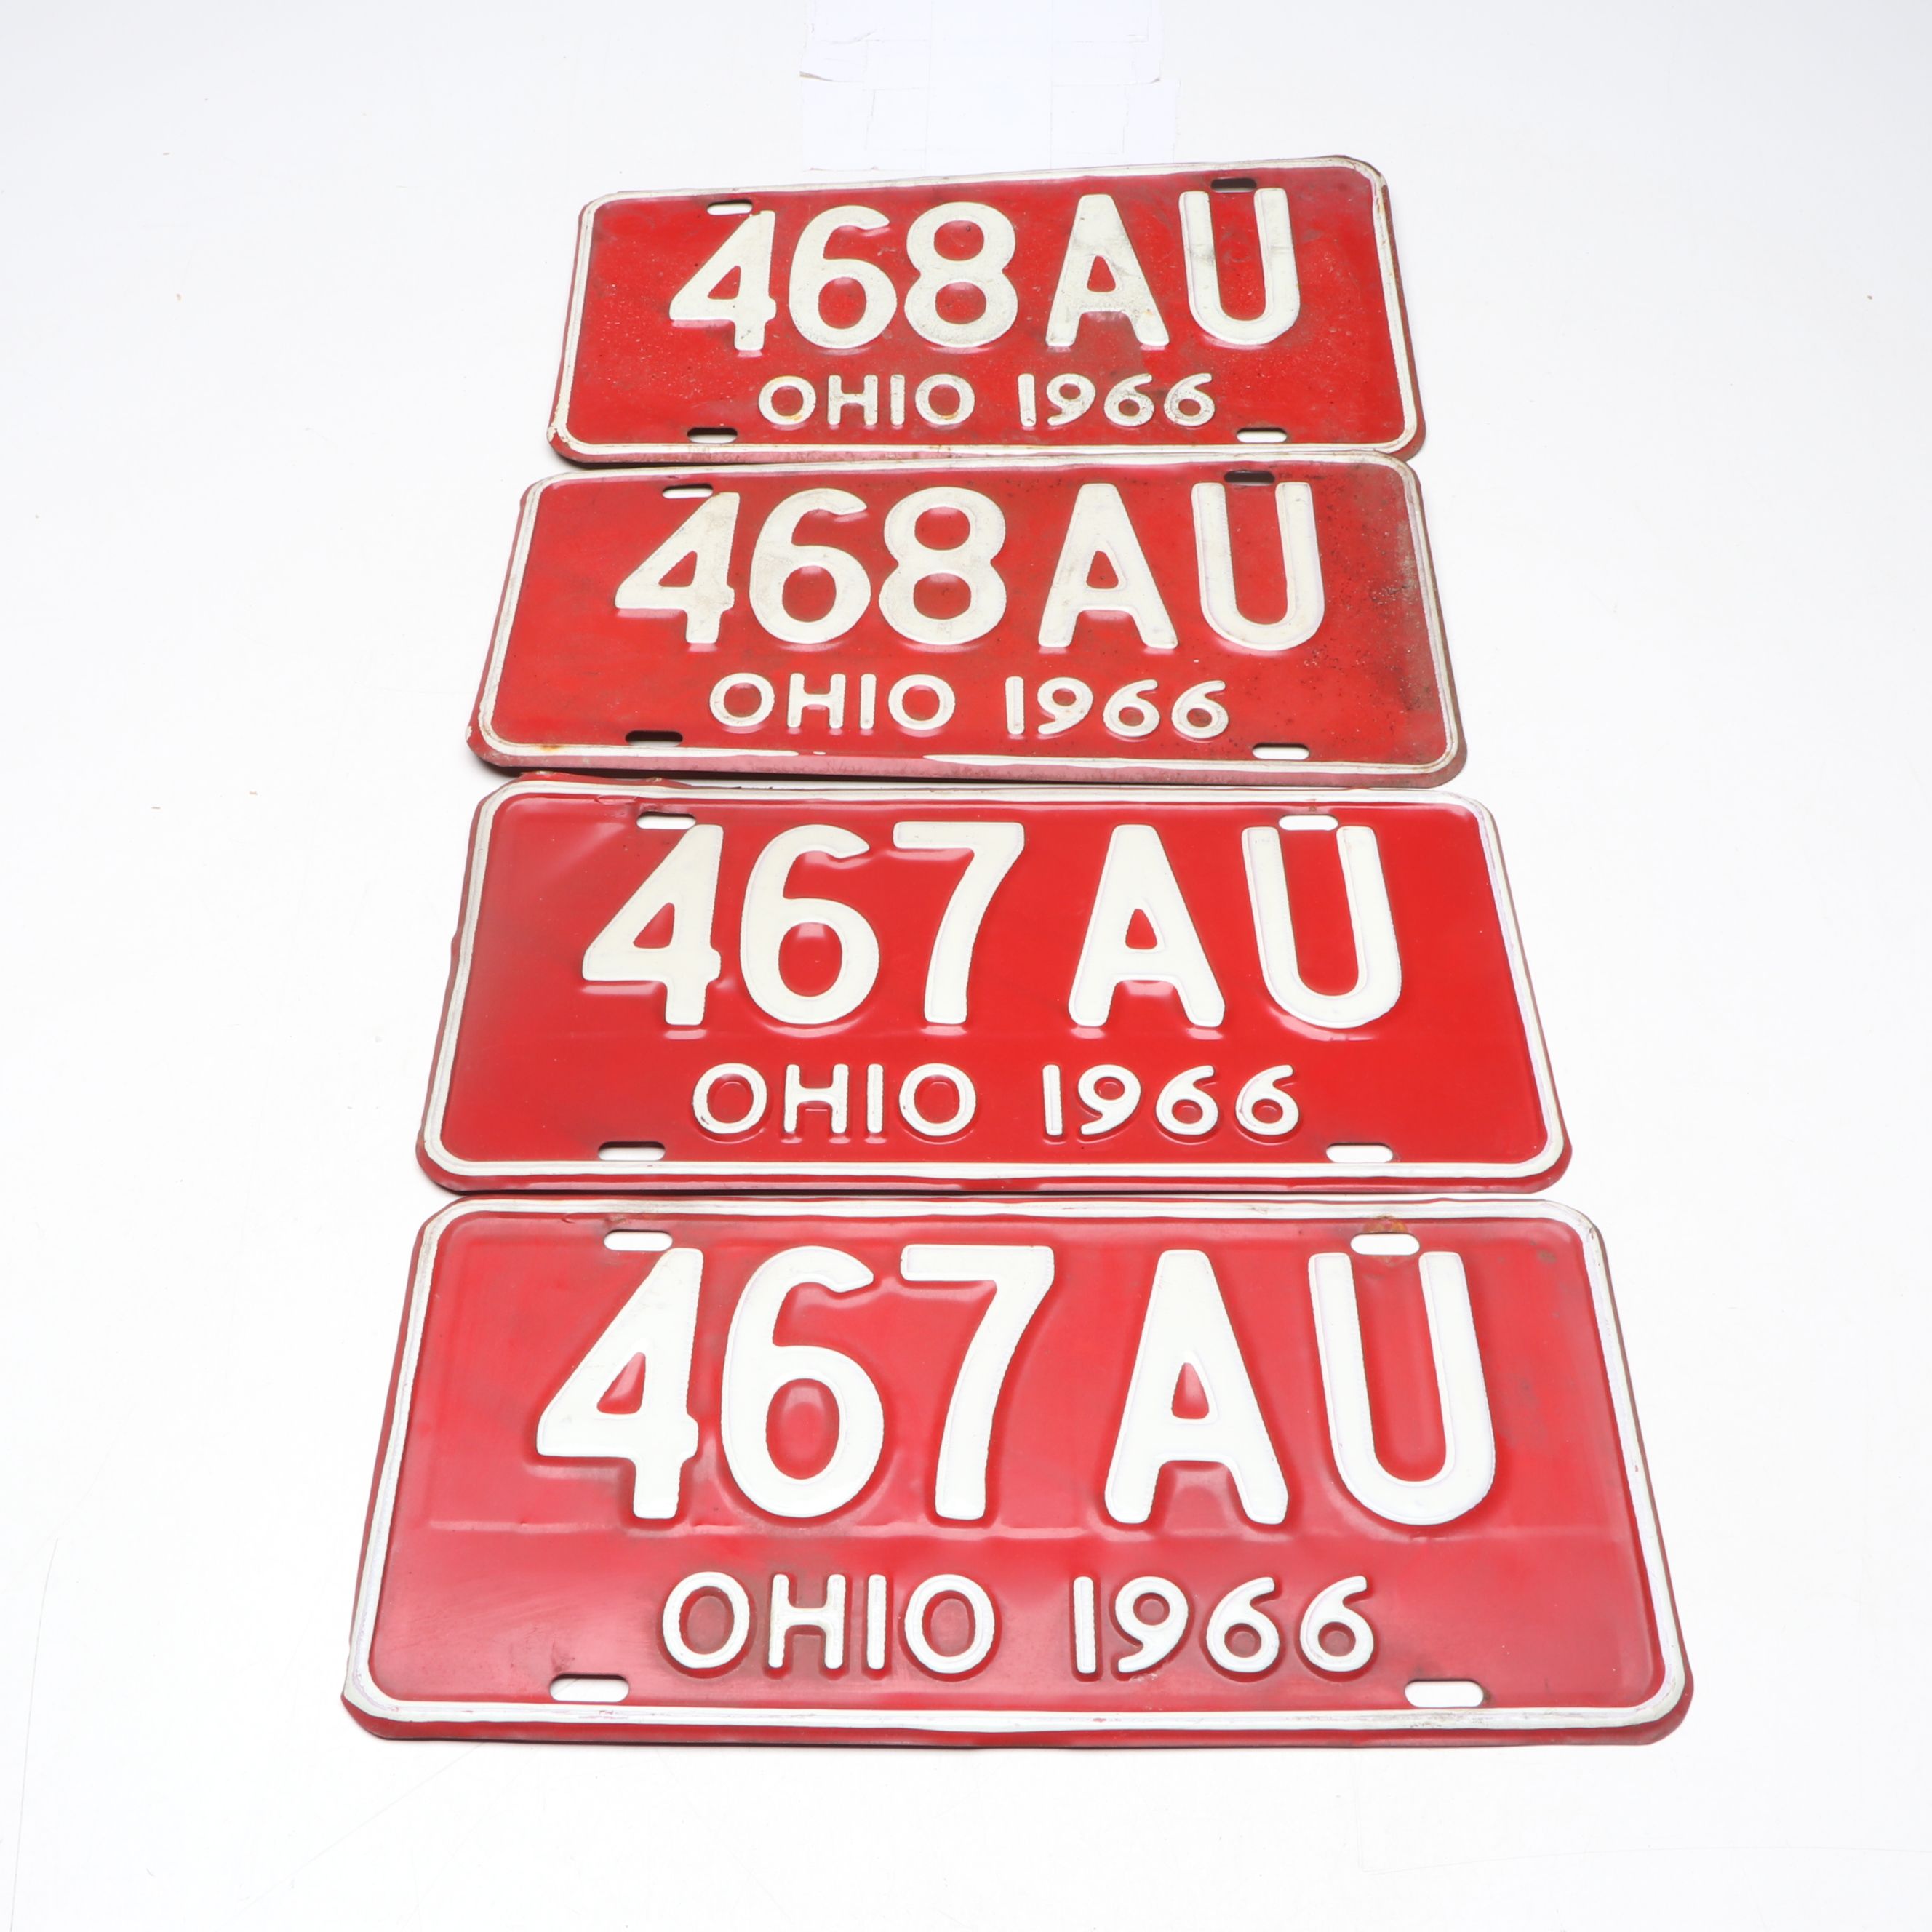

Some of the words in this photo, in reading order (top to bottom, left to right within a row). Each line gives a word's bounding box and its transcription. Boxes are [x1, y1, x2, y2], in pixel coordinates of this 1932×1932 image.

[757, 372, 976, 430] OHIO
[1016, 372, 1216, 430] 1966
[708, 671, 957, 735] OHIO
[1004, 675, 1230, 740] 1966
[690, 1062, 978, 1138] OHIO
[1042, 1063, 1300, 1139] 1966
[660, 1570, 997, 1675] OHIO
[1072, 1574, 1376, 1676] 1966
